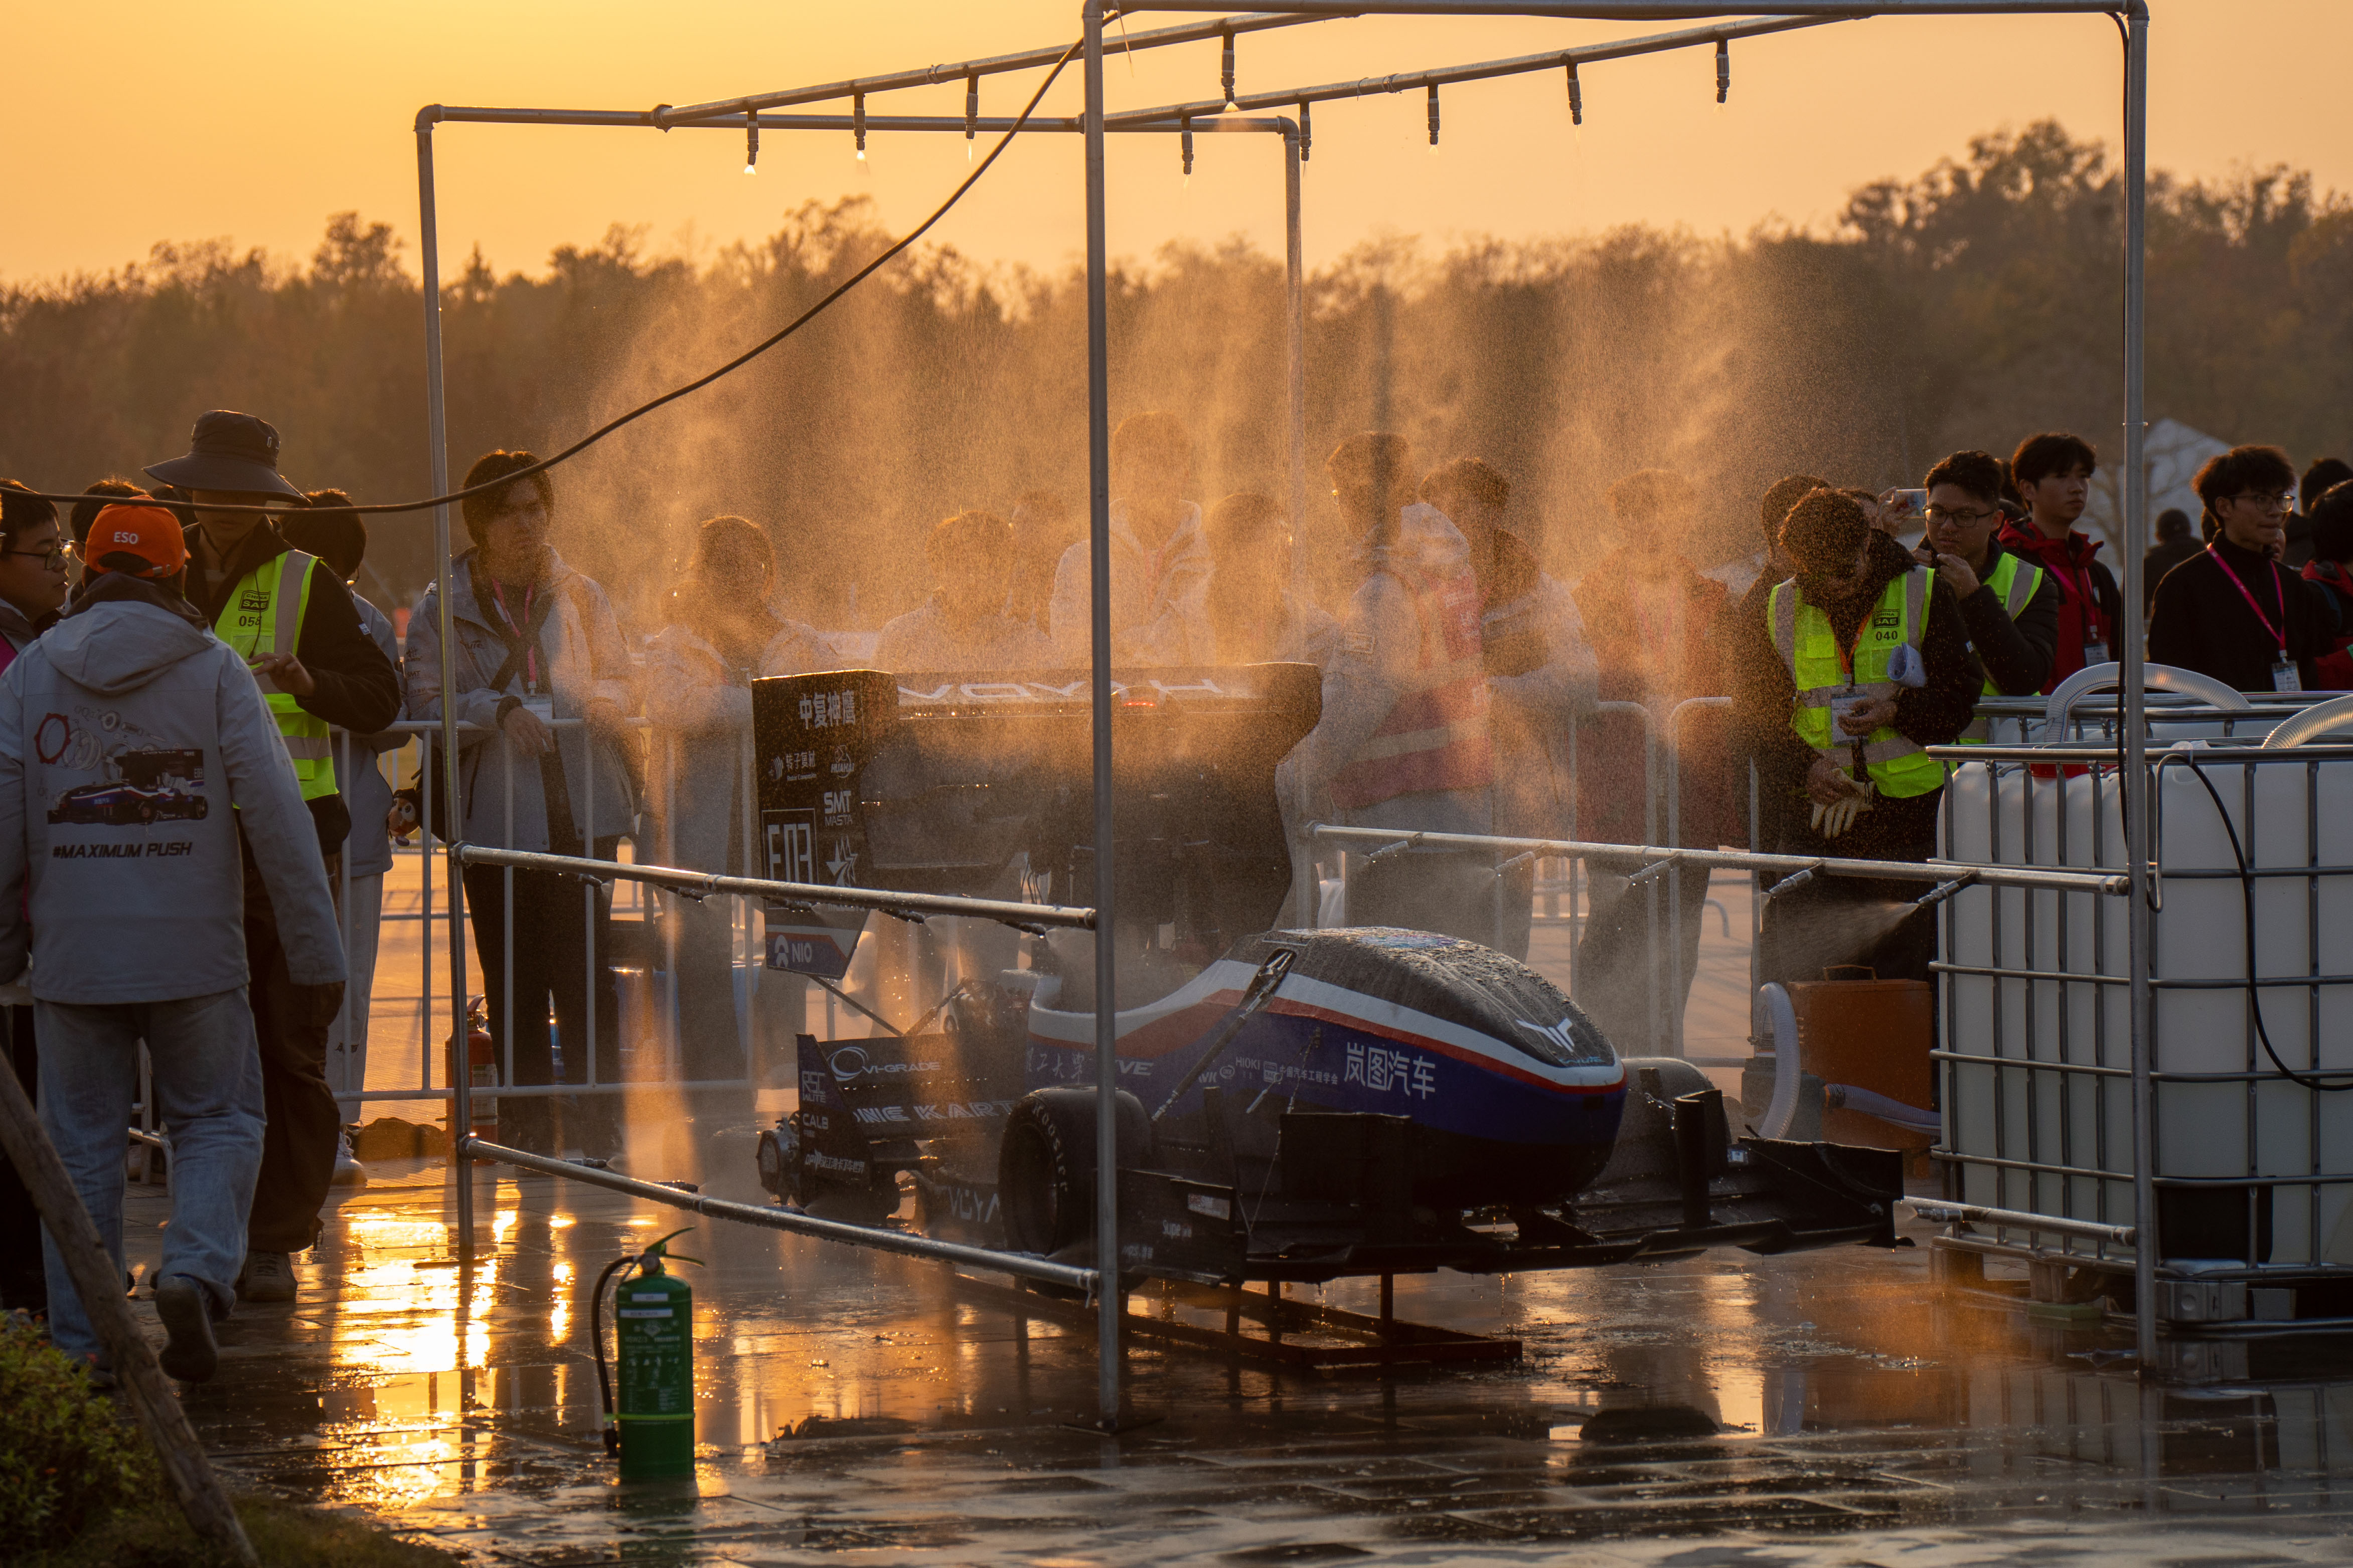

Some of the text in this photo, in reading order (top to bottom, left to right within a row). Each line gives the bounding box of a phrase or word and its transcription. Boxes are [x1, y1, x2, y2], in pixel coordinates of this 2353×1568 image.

[113, 532, 139, 545] ESO
[242, 600, 267, 609] SAE
[1876, 630, 1898, 641] 040
[824, 790, 852, 814] SMT
[825, 814, 853, 827] MASTA
[53, 842, 193, 858] #MAXIMUM PUSH
[792, 942, 812, 963] NIO
[1235, 1056, 1261, 1071] HIOKI
[1344, 1041, 1436, 1100] 岚图汽车
[803, 1113, 828, 1129] CALB
